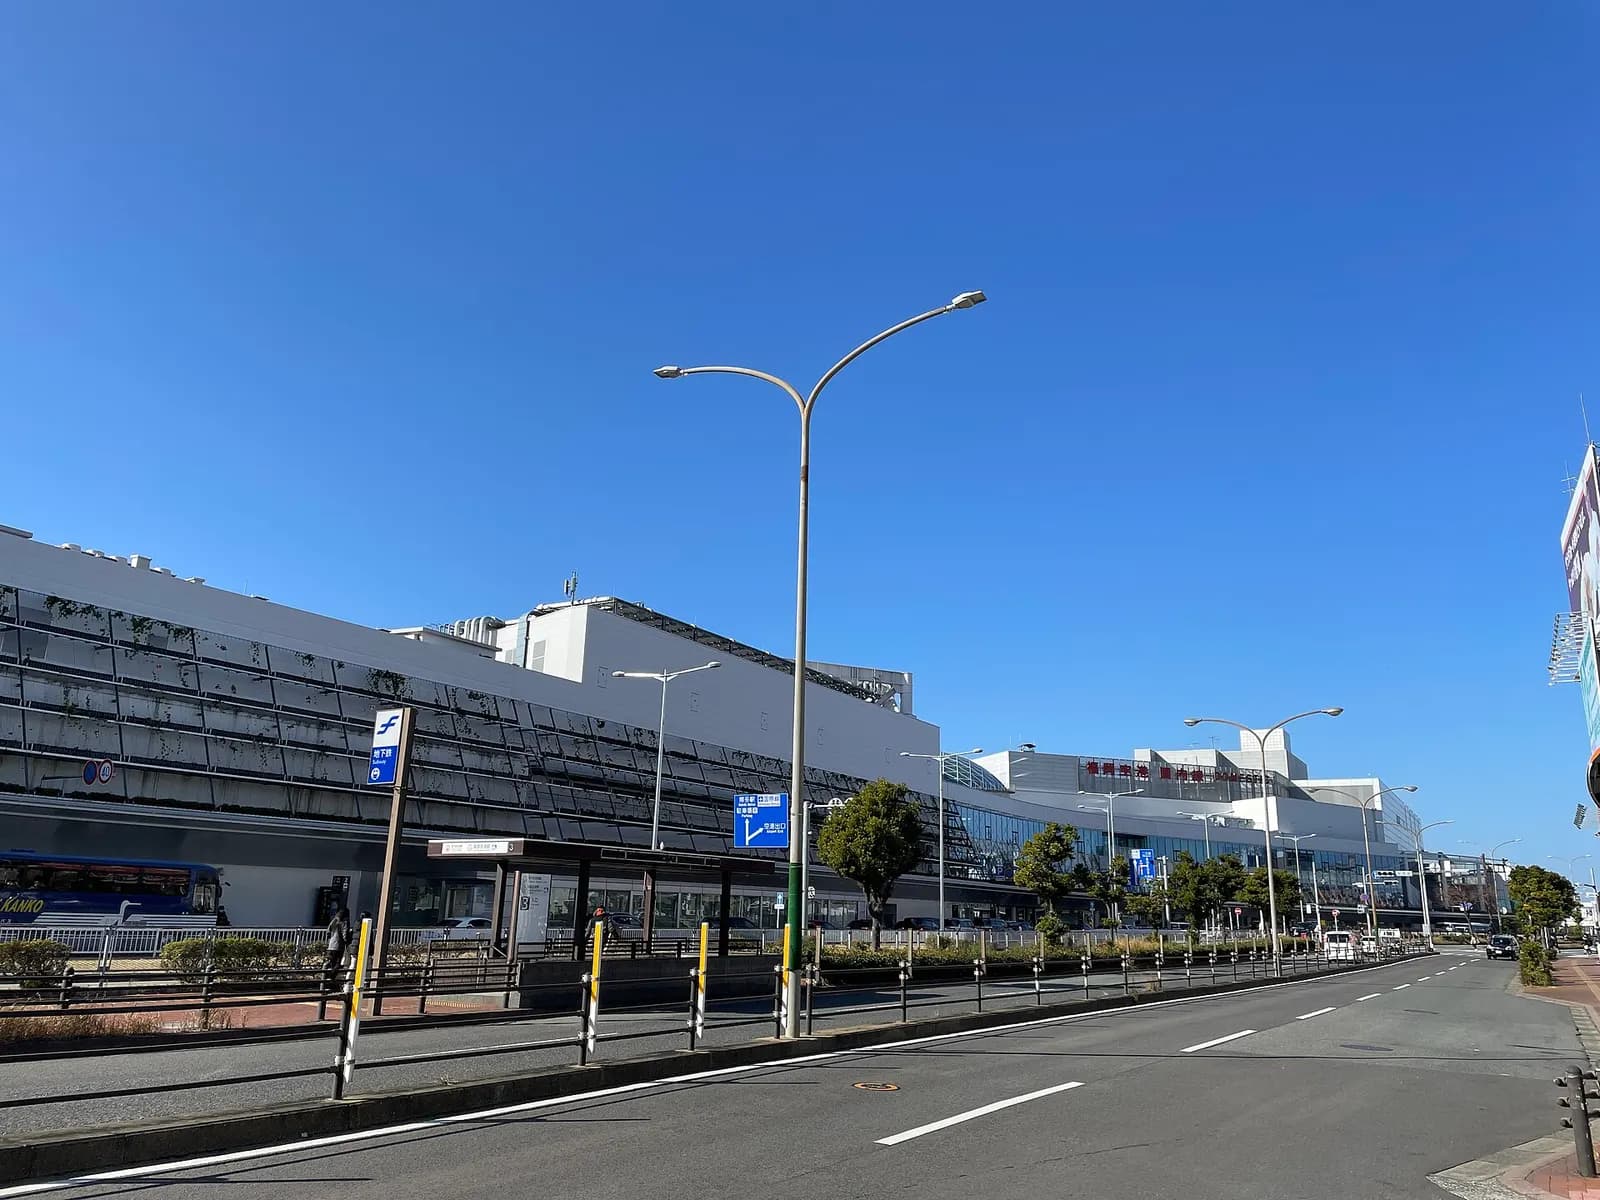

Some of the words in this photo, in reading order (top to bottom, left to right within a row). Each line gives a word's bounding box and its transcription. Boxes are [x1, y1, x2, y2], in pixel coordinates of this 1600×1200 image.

[373, 748, 392, 759] 地下鉄
[102, 766, 110, 777] 40
[1087, 761, 1149, 779] 福岡空港
[0, 896, 44, 913] KANKO
